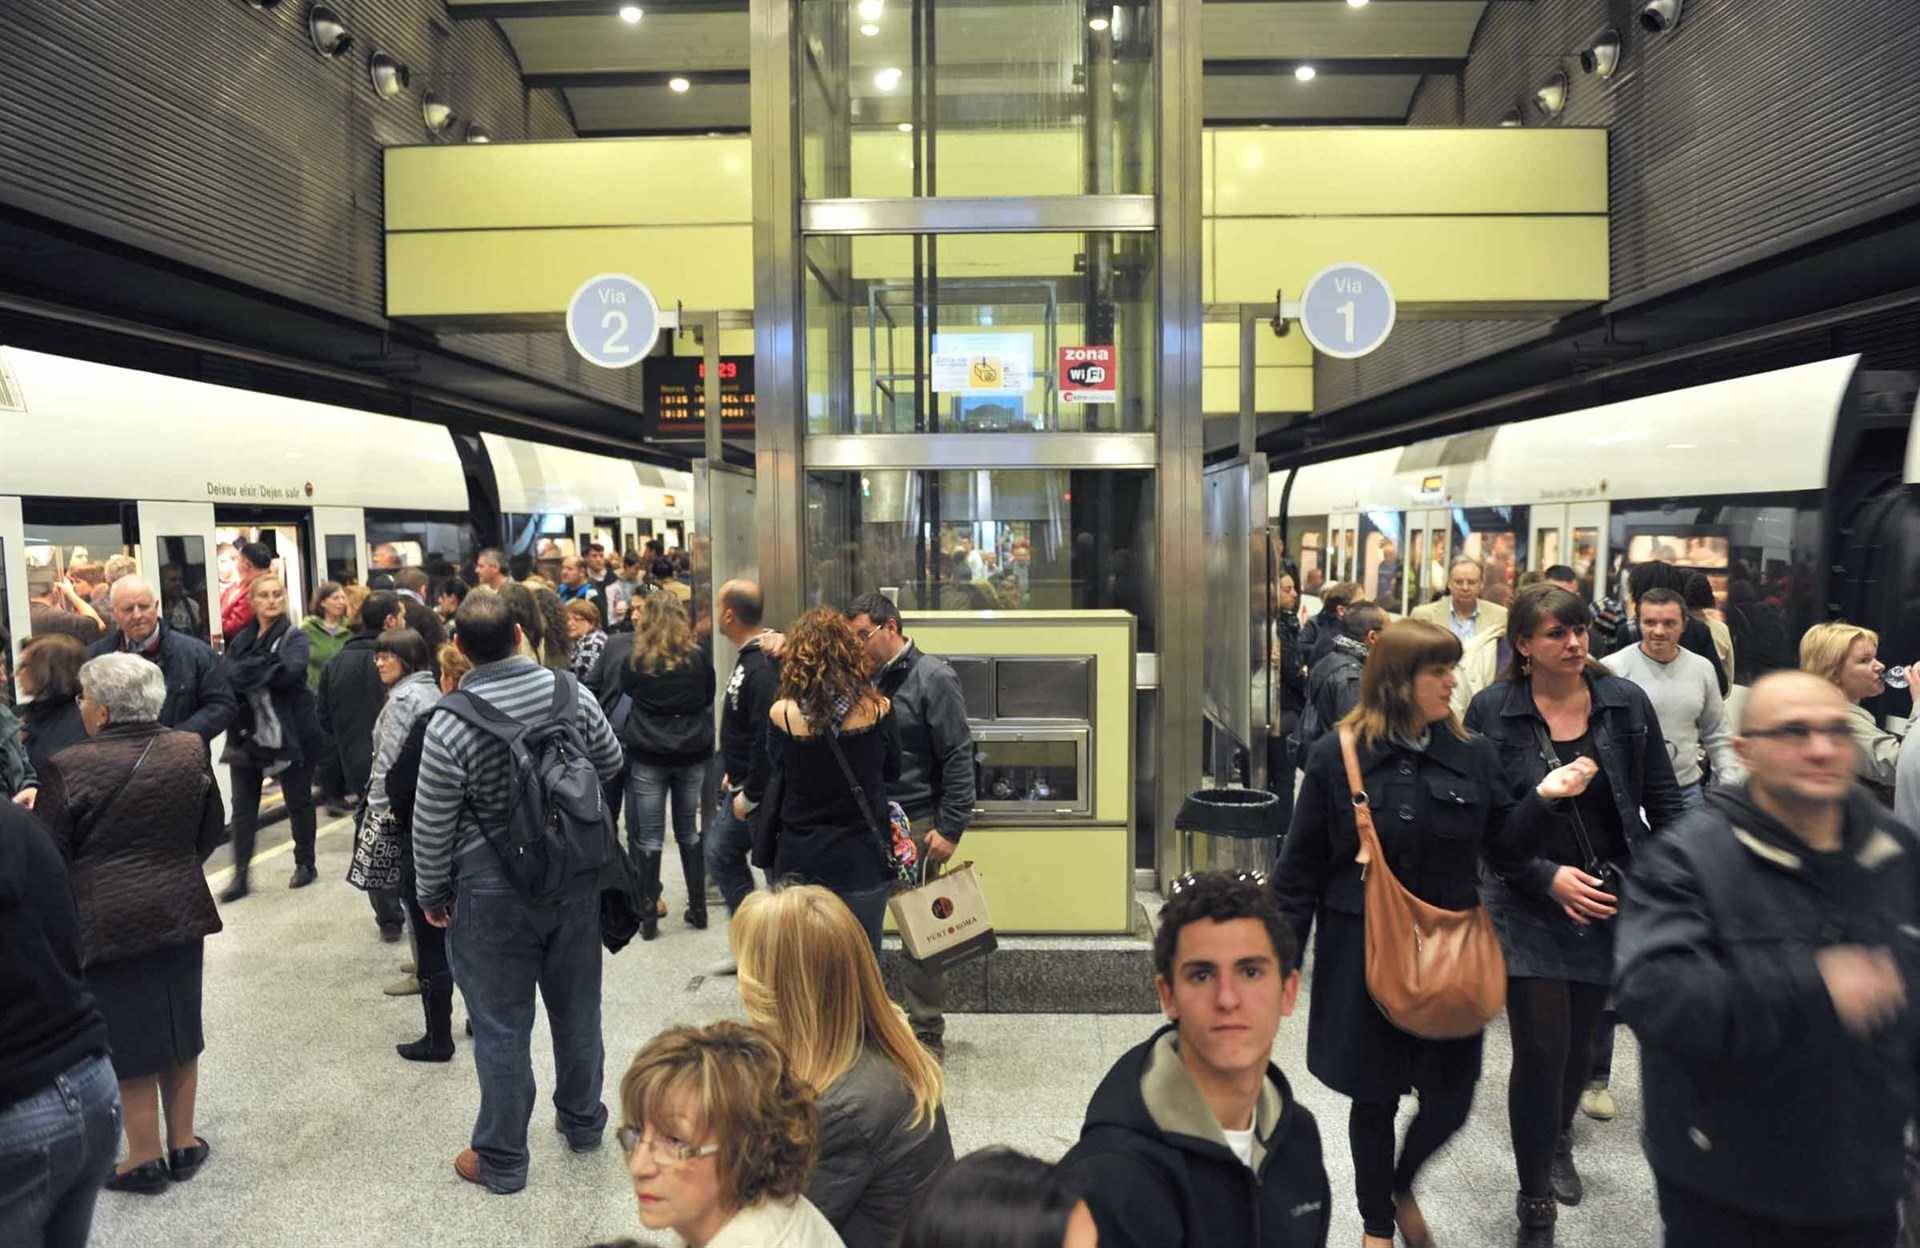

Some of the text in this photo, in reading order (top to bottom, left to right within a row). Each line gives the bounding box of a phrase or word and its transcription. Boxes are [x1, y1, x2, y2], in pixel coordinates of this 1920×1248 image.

[1334, 276, 1362, 294] Via
[598, 287, 626, 304] Via
[1335, 301, 1354, 343] 1
[601, 311, 630, 353] 2
[1064, 350, 1109, 361] zona
[955, 916, 978, 930] ROMA
